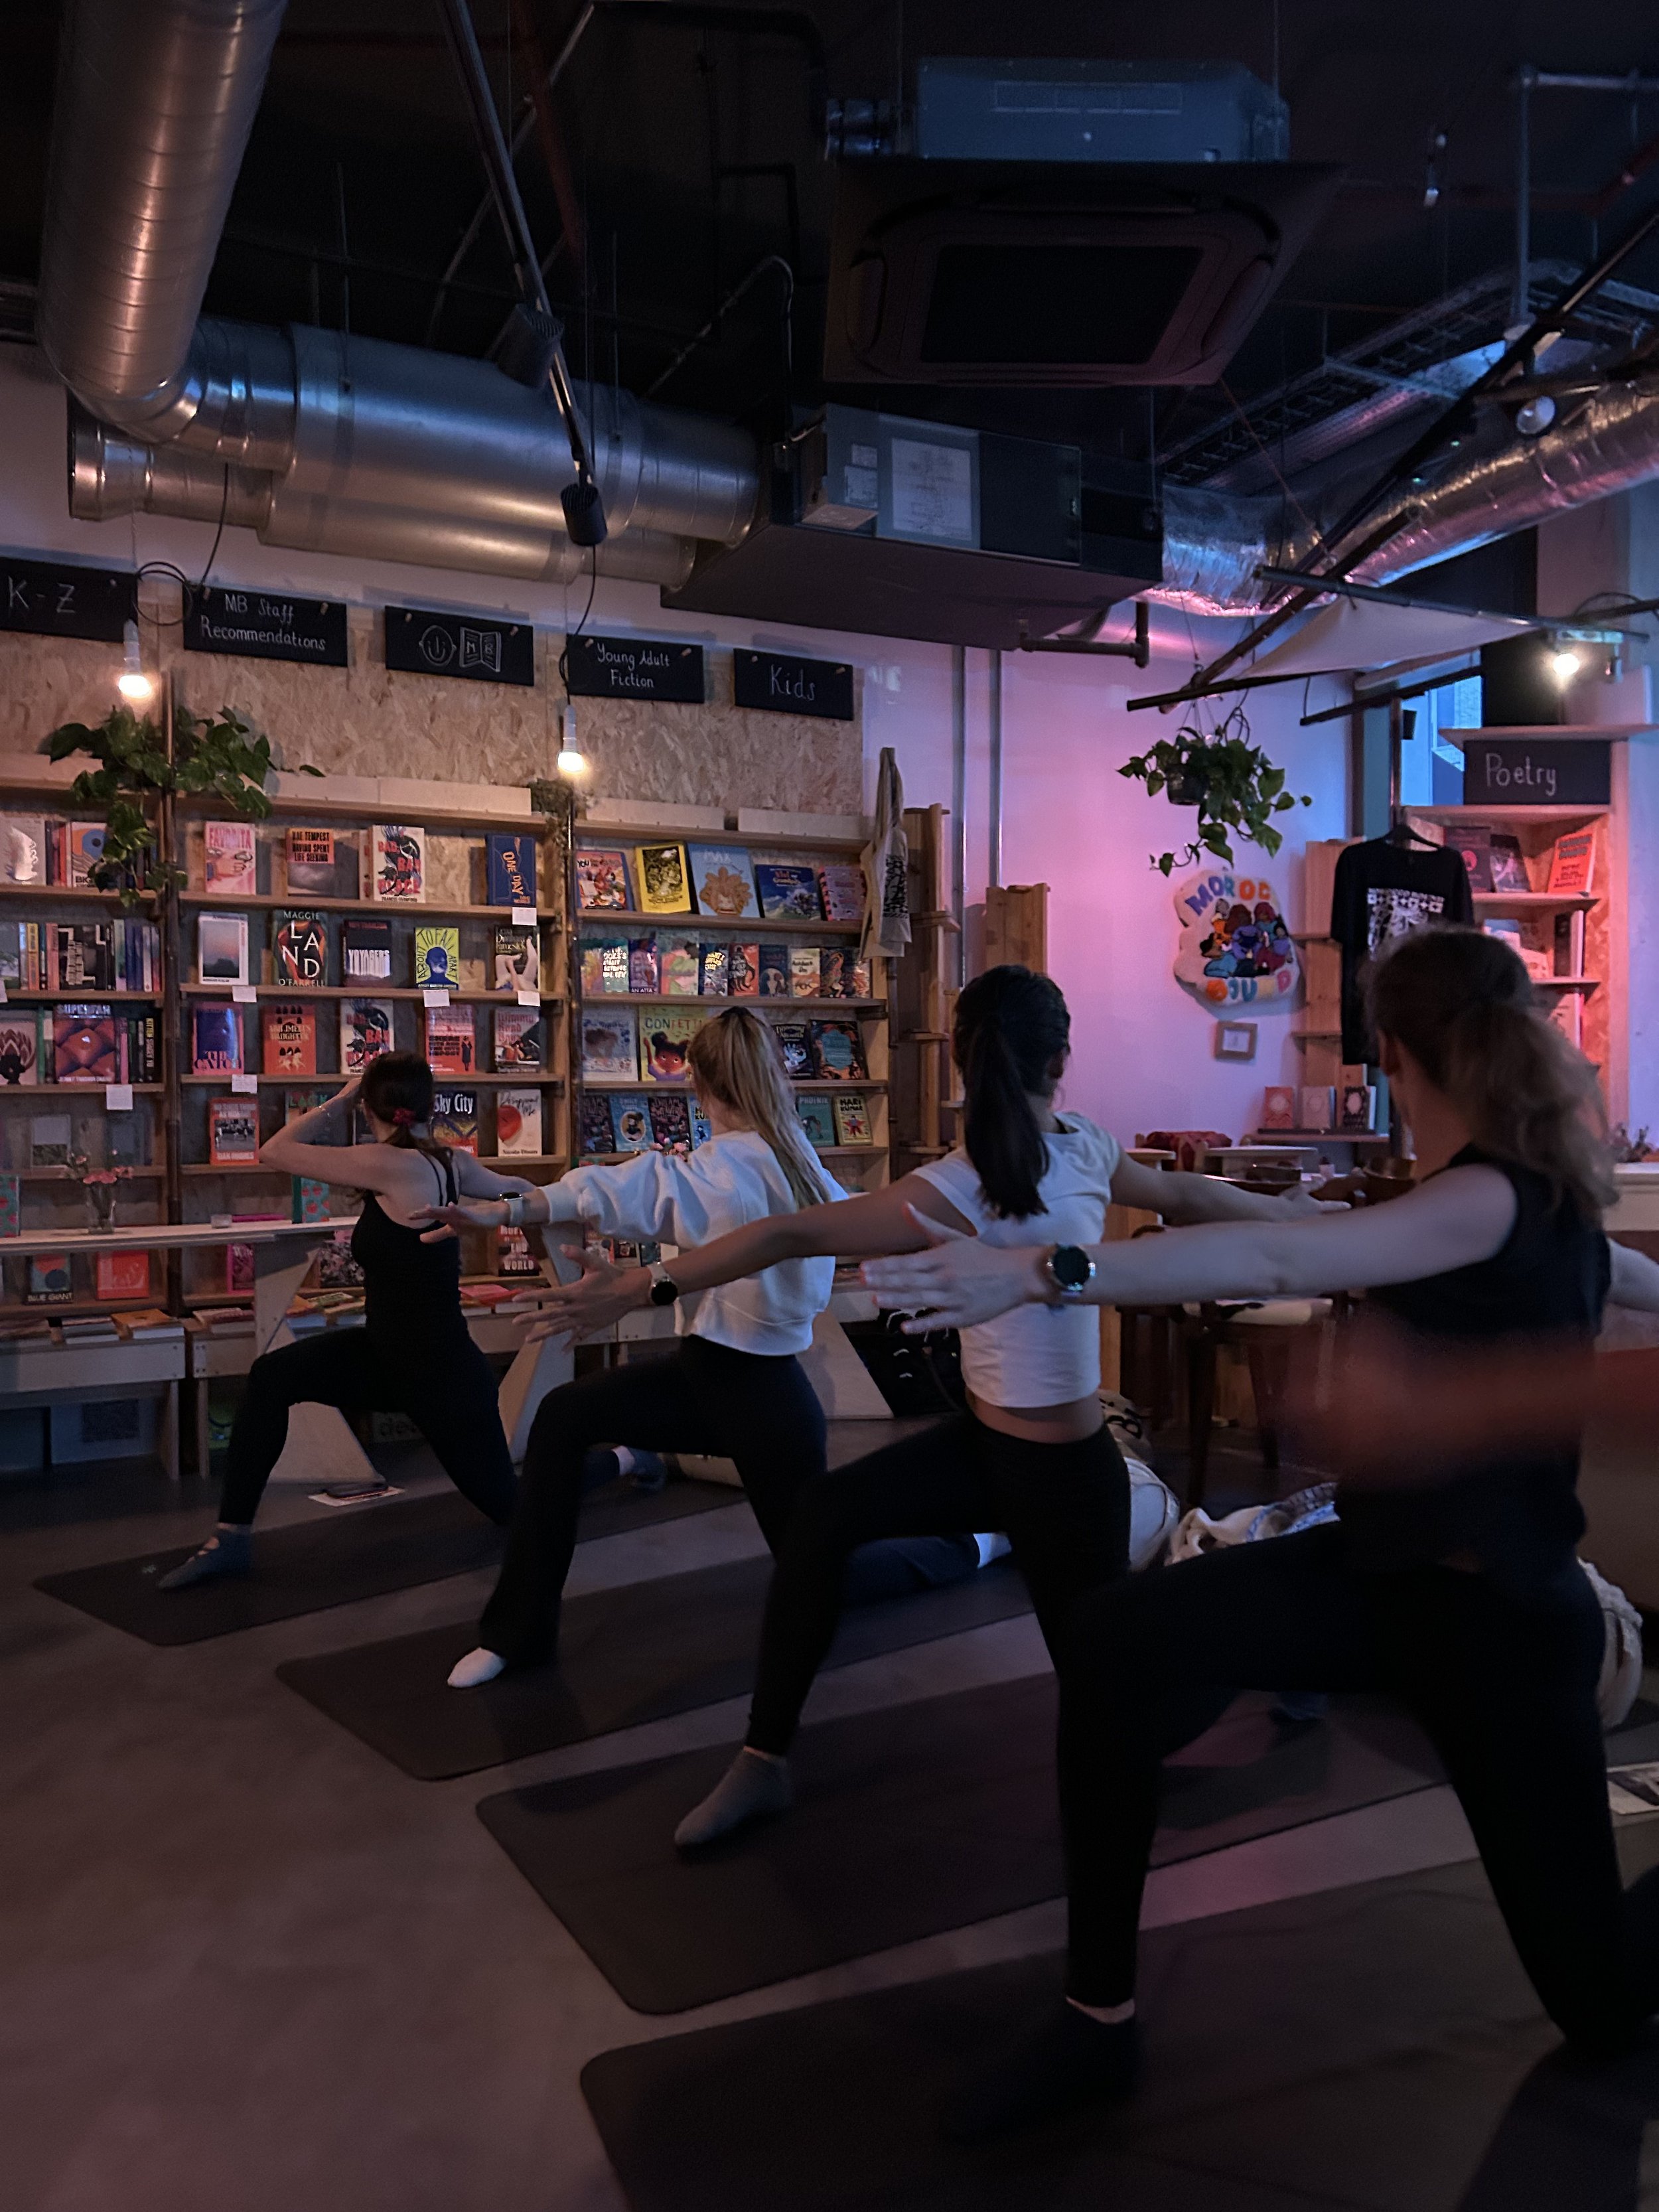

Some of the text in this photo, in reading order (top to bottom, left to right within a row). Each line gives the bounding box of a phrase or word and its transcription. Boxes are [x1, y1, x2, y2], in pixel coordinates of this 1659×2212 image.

[8, 575, 30, 609] K
[56, 581, 76, 614] Z
[224, 593, 295, 625] MB Staff
[200, 614, 326, 652] Recommendations
[597, 642, 670, 672] Young Adult
[610, 668, 655, 689] Fiction
[770, 664, 816, 701] Kids
[1485, 752, 1557, 797] Poetry
[502, 850, 517, 873] ONE
[510, 874, 524, 896] DAY
[283, 910, 320, 921] MAGGIE
[434, 1094, 474, 1115] Sky City
